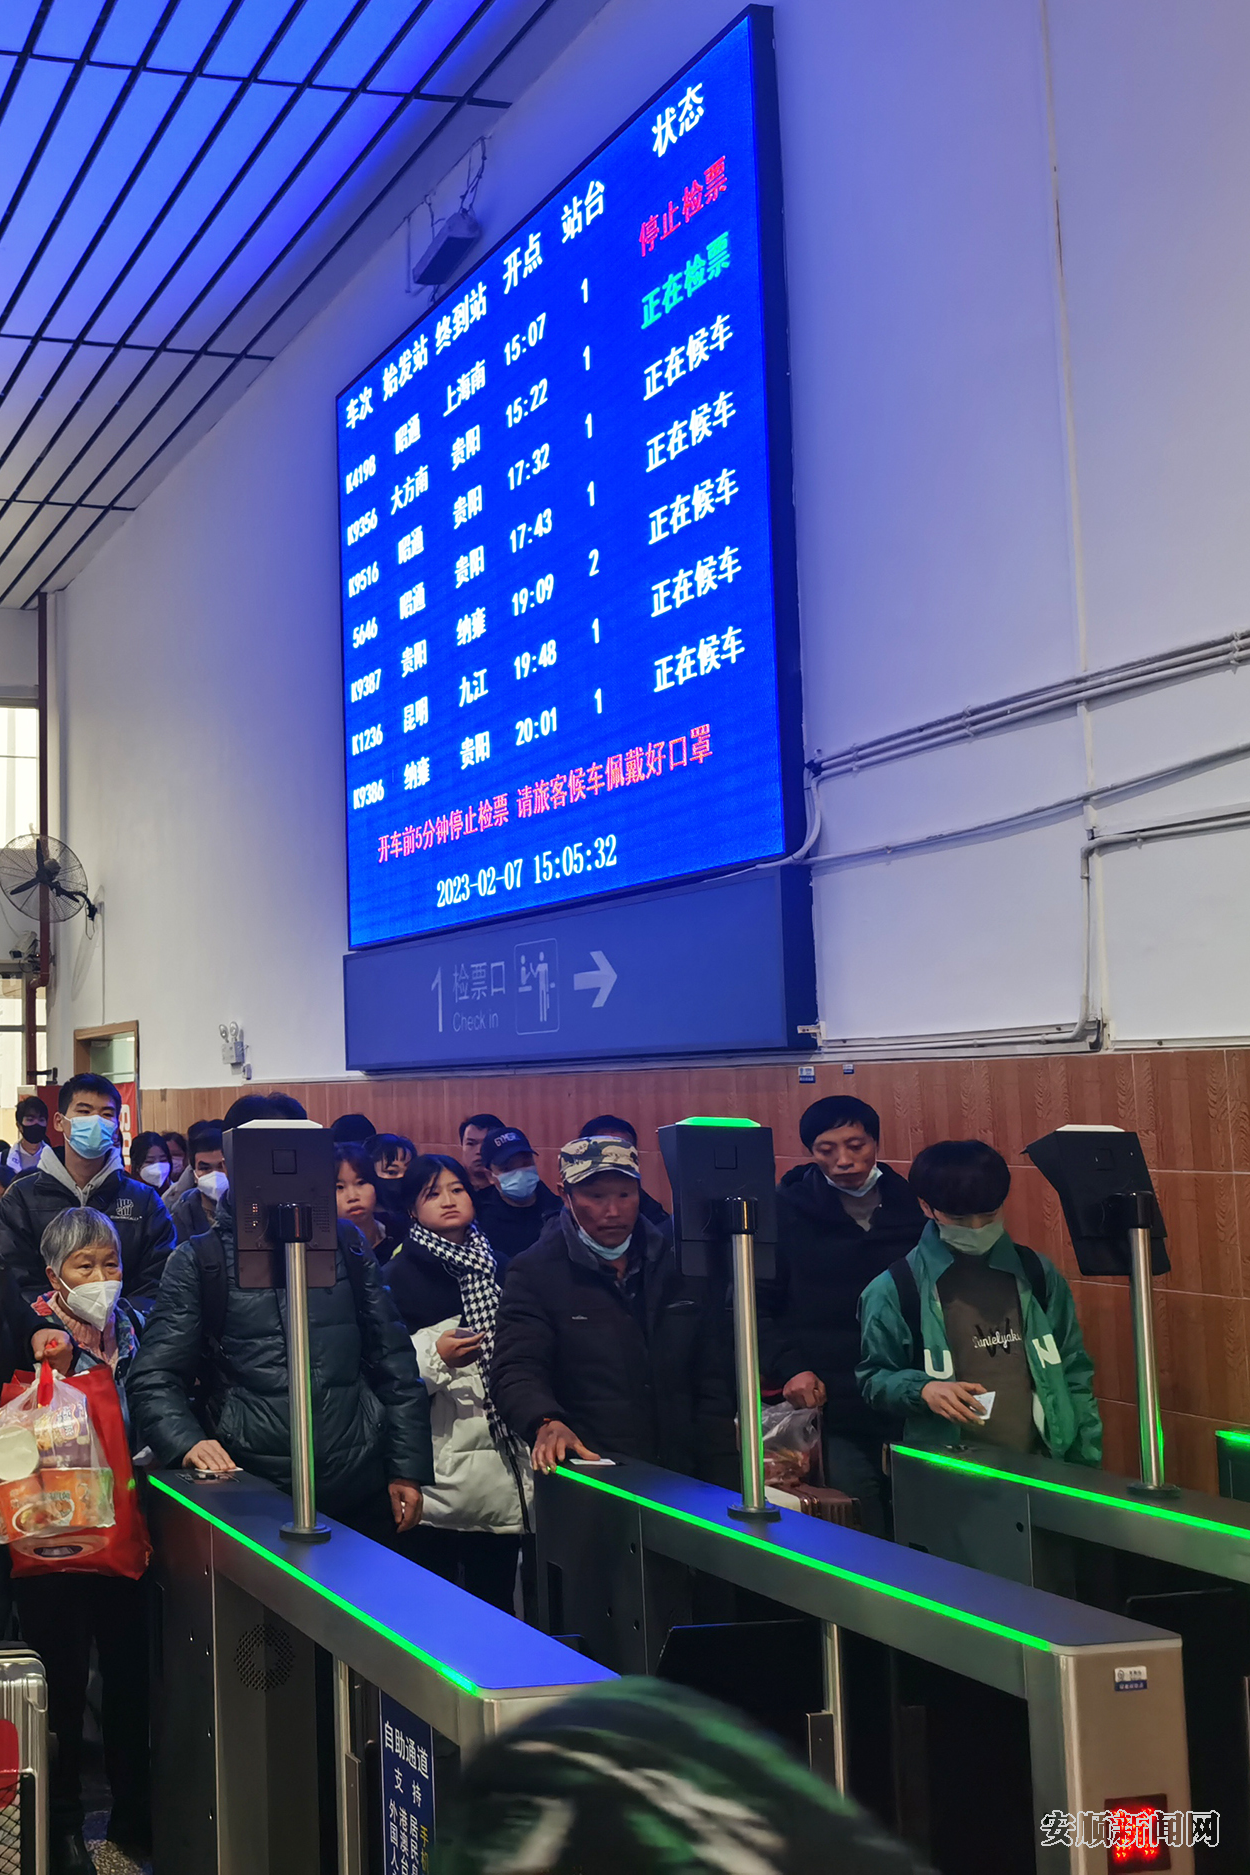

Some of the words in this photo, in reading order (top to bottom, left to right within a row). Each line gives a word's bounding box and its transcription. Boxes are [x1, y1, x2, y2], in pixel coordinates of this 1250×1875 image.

[345, 386, 374, 430] 车次
[382, 335, 429, 402] 始发站
[434, 281, 487, 355] 终到站
[503, 231, 543, 295] 开点
[561, 180, 605, 244] 站台
[651, 82, 705, 158] 状态
[345, 454, 377, 495] K4198
[442, 358, 486, 418] 上海南
[503, 312, 547, 366] 15:07
[580, 277, 589, 304] 1
[638, 155, 728, 258] 停止检票
[346, 507, 378, 547] K9356
[390, 464, 429, 516] 大方南
[450, 424, 481, 472] 贵阳
[505, 377, 548, 429] 15:22
[582, 345, 591, 371] 1
[640, 231, 731, 330] 正在检票
[348, 560, 380, 599] K9516
[452, 484, 483, 530] 贵阳
[507, 442, 550, 491] 17:32
[584, 412, 593, 439] 1
[643, 314, 734, 401] 正在候车
[350, 667, 382, 703] K9387
[400, 638, 428, 678] 贵阳
[511, 573, 555, 617] 19:09
[588, 548, 600, 577] 2
[648, 468, 739, 545] 正在候车
[352, 616, 379, 649] 5646
[454, 544, 485, 589] 贵阳
[509, 507, 553, 554] 17:43
[586, 480, 595, 507] 1
[645, 390, 737, 473] 正在候车
[351, 723, 384, 756] K1236
[402, 695, 429, 734] 昆明
[458, 668, 489, 708] 九江
[513, 638, 557, 681] 19:48
[591, 617, 600, 644] 1
[650, 545, 742, 618] 正在候车
[352, 778, 386, 810] K9386
[459, 730, 491, 771] 贵阳
[514, 706, 557, 747] 20:01
[593, 687, 603, 715] 1
[653, 625, 746, 693] 正在候车
[377, 792, 510, 864] 开车前5分钟停止检票
[516, 723, 714, 819] 请旅客候车佩戴好口罩
[436, 858, 524, 908] 2023-02-07
[533, 833, 618, 885] 15:05:32
[431, 965, 444, 1033] 1
[452, 960, 506, 1004] 检票口
[452, 1009, 487, 1033] Check
[488, 1007, 500, 1029] in
[383, 1720, 430, 1780] 自助通道
[389, 1798, 399, 1875] 外国人
